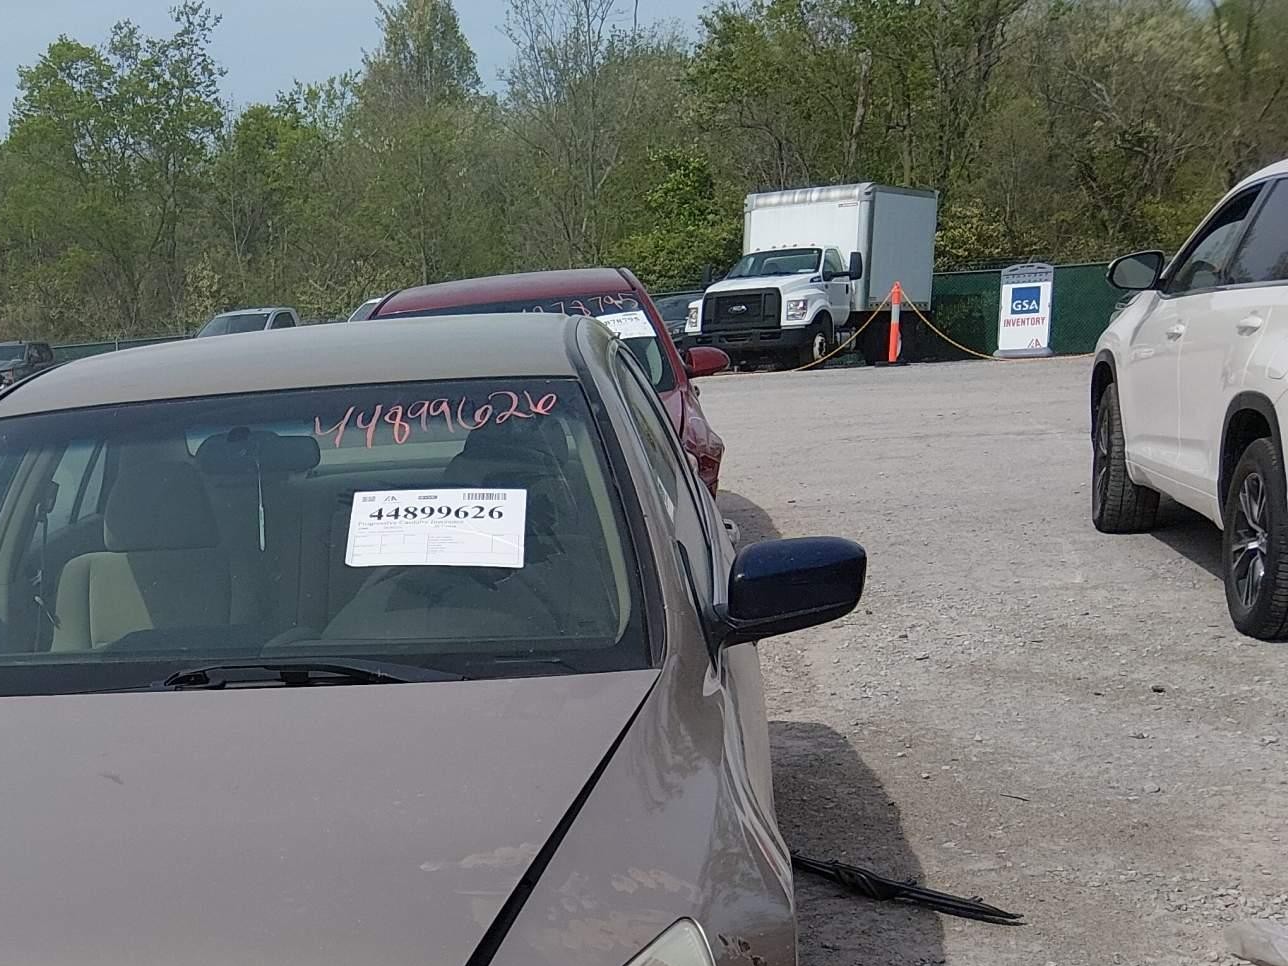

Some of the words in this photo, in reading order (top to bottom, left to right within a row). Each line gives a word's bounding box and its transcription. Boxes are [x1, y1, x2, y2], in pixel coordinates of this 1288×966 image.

[1012, 299, 1039, 311] GSA
[1003, 316, 1046, 328] INVENTORY
[314, 390, 557, 449] 44899626
[369, 505, 504, 521] 44899626
